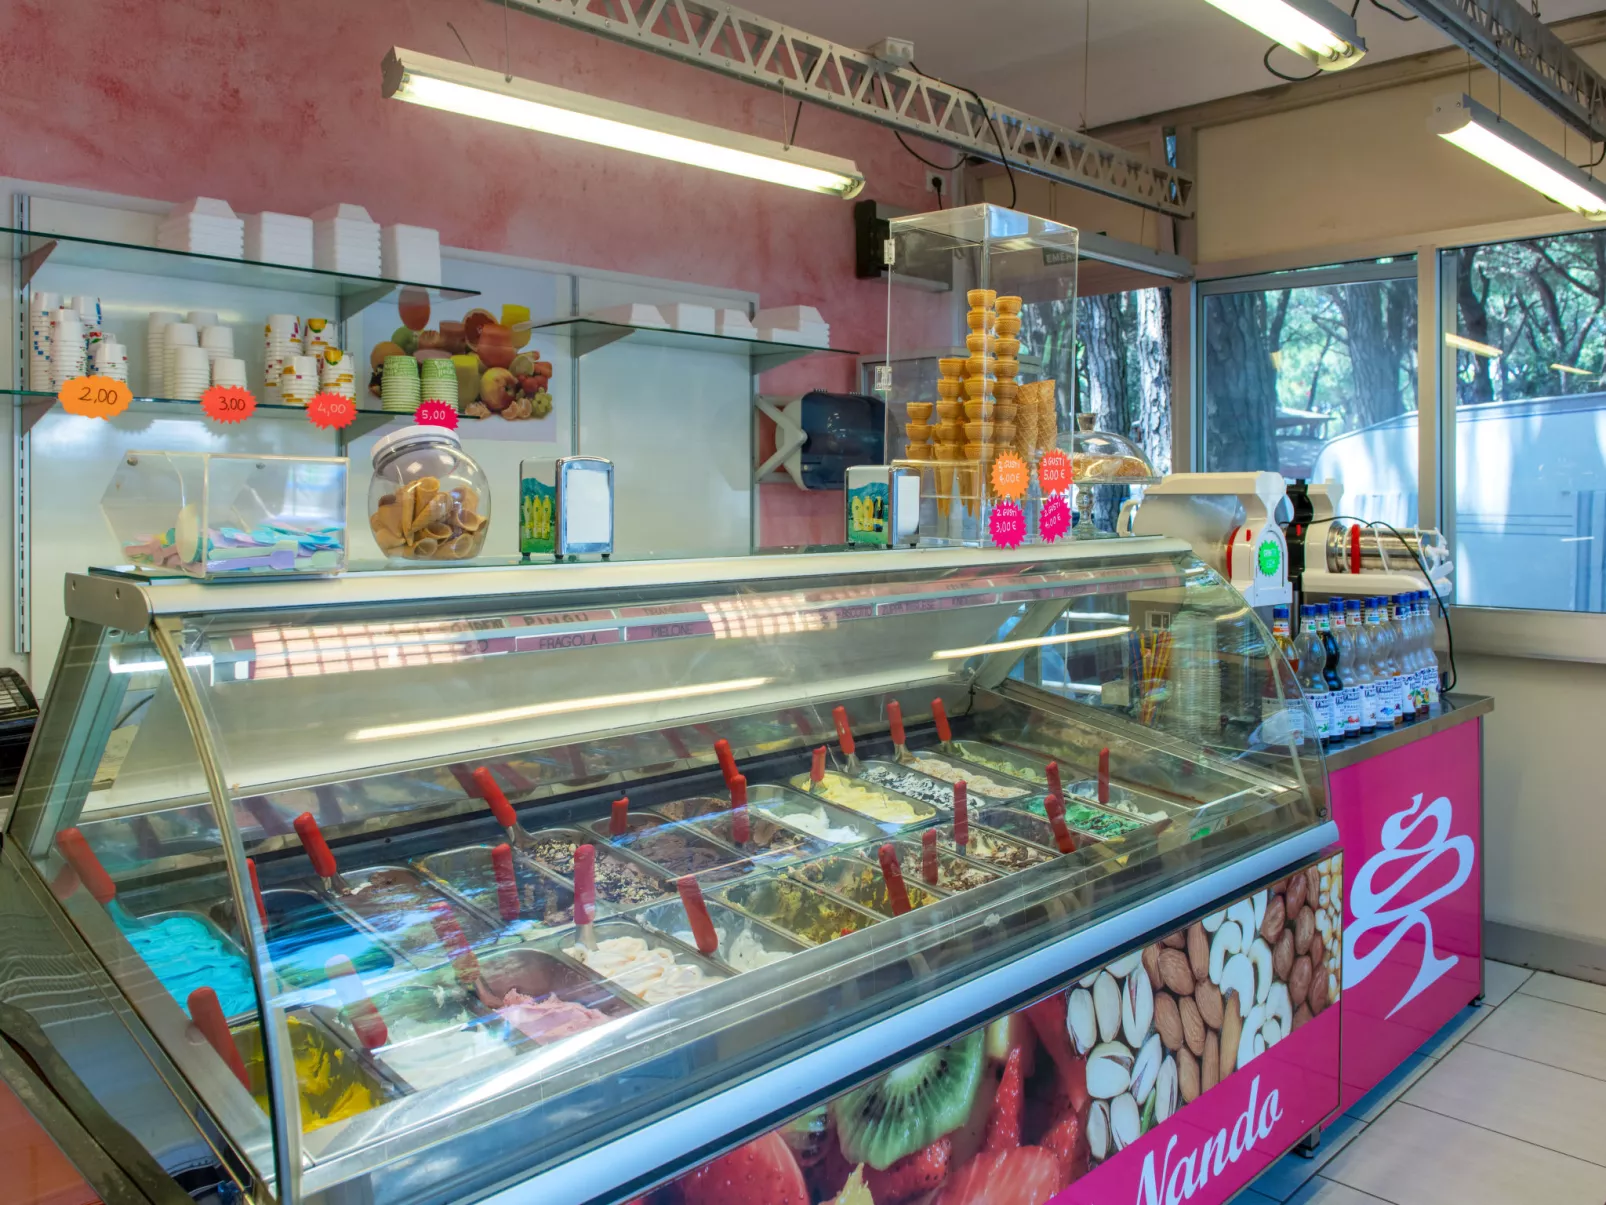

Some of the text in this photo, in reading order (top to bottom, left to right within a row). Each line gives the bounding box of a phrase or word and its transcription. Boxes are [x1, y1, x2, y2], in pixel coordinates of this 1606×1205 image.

[78, 386, 118, 405] 2,00
[317, 403, 346, 417] 4,00
[421, 409, 446, 421] 5,00
[1043, 457, 1065, 467] 3 GUSTI
[1004, 509, 1018, 517] GUSTI
[1048, 502, 1061, 514] GUSTI
[523, 613, 589, 627] PINGU
[650, 623, 694, 638] MELONE
[539, 633, 598, 649] FRAGOLA
[1136, 1074, 1284, 1205] Nando
